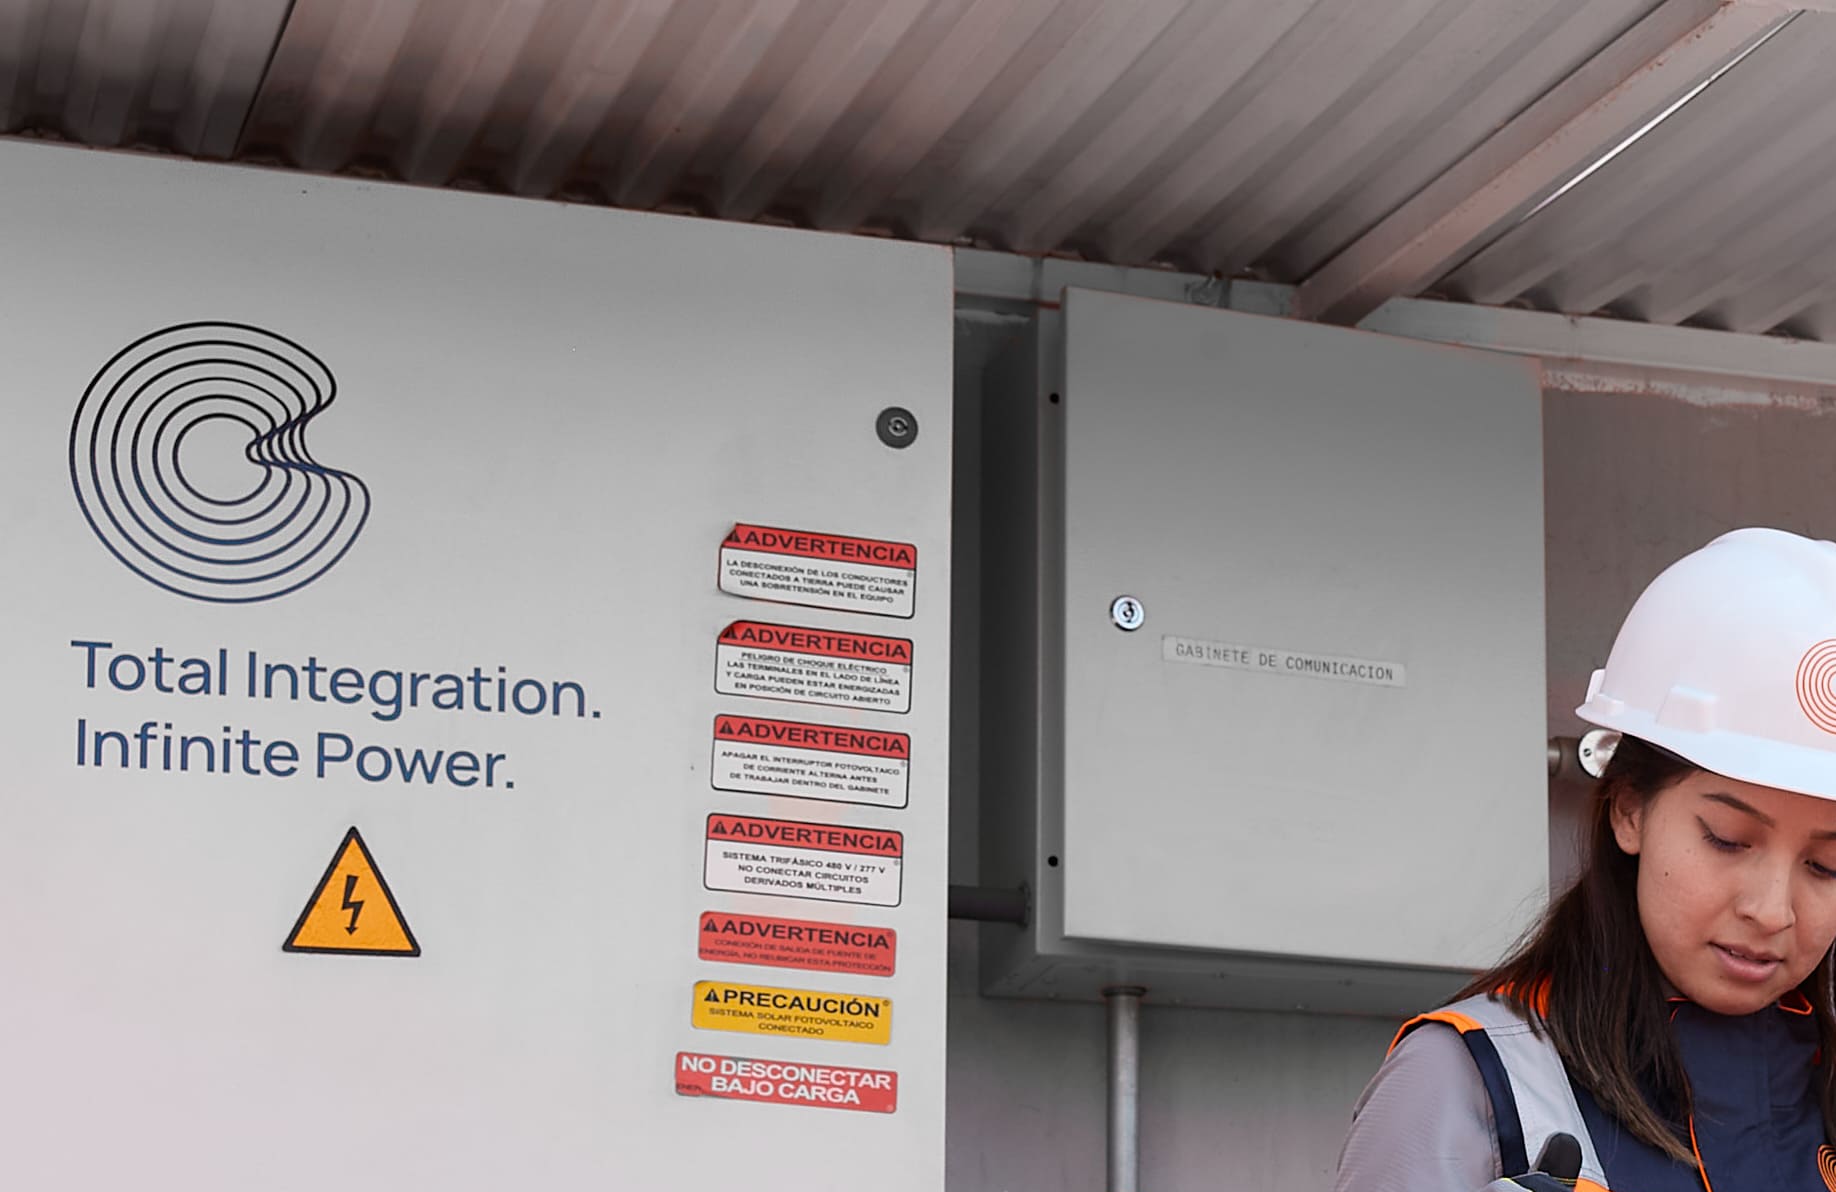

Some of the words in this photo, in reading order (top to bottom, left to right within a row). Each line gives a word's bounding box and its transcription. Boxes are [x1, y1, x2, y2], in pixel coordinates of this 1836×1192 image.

[744, 531, 911, 563] ADVERTENCIA
[729, 569, 790, 582] CONECTADOS
[803, 577, 834, 586] TIERRA
[836, 581, 865, 590] PUEDE
[868, 585, 904, 594] CAUSAR
[740, 560, 804, 574] DESCONEXIÓN
[841, 573, 908, 586] CONDUCTORES
[740, 579, 759, 587] UNA
[762, 582, 830, 595] SOBRETENSIÓN
[860, 593, 893, 603] EQUIPO
[741, 628, 907, 658] ADVERTENCIA
[727, 660, 744, 668] LAS
[748, 663, 803, 674] TERMINALES
[741, 652, 780, 662] PELIGRO
[783, 656, 794, 664] DE
[797, 658, 834, 668] CHOQUE
[1259, 653, 1276, 668] DE
[71, 640, 227, 696] Total
[247, 650, 601, 721] Integration.
[734, 671, 765, 681] CARGA
[768, 675, 804, 685] PUEDEN
[838, 683, 900, 696] ENERGIZADAS
[749, 683, 791, 694] POSICIÓN
[793, 688, 805, 696] DE
[808, 690, 849, 700] CIRCUITO
[852, 695, 890, 705] ABIERTO
[737, 722, 904, 753] ADVERTENCIA
[77, 718, 299, 777] Infinite
[317, 732, 514, 789] Power.
[722, 751, 757, 760] APAGAR
[773, 756, 832, 768] INTERRUPTOR
[835, 762, 899, 775] FOTOVOLTAICO
[744, 774, 789, 783] TRABAJAR
[792, 779, 827, 788] DENTRO
[829, 782, 844, 790] DEL
[847, 784, 889, 795] GABINETE
[757, 765, 805, 775] CORRIENTE
[808, 770, 847, 779] ALTERNA
[850, 775, 877, 783] ANTES
[731, 822, 897, 851] ADVERTENCIA
[722, 851, 767, 862] SISTEMA
[879, 866, 885, 874] V
[738, 864, 753, 872] NO
[756, 866, 811, 877] CONECTAR
[815, 872, 869, 883] CIRCUITOS
[744, 876, 803, 888] DERIVADOS
[722, 920, 889, 949] ADVERTENCIA
[724, 989, 879, 1017] PRECAUCIÓN
[709, 1007, 754, 1018] SISTEMA
[756, 1012, 791, 1022] SOLAR
[794, 1015, 874, 1030] FOTOVOLTAICO
[758, 1022, 824, 1035] CONECTADO
[681, 1055, 715, 1073] NO
[720, 1060, 891, 1090] DESCONECTAR
[711, 1076, 774, 1096] BAJO
[778, 1082, 861, 1104] CARGA
